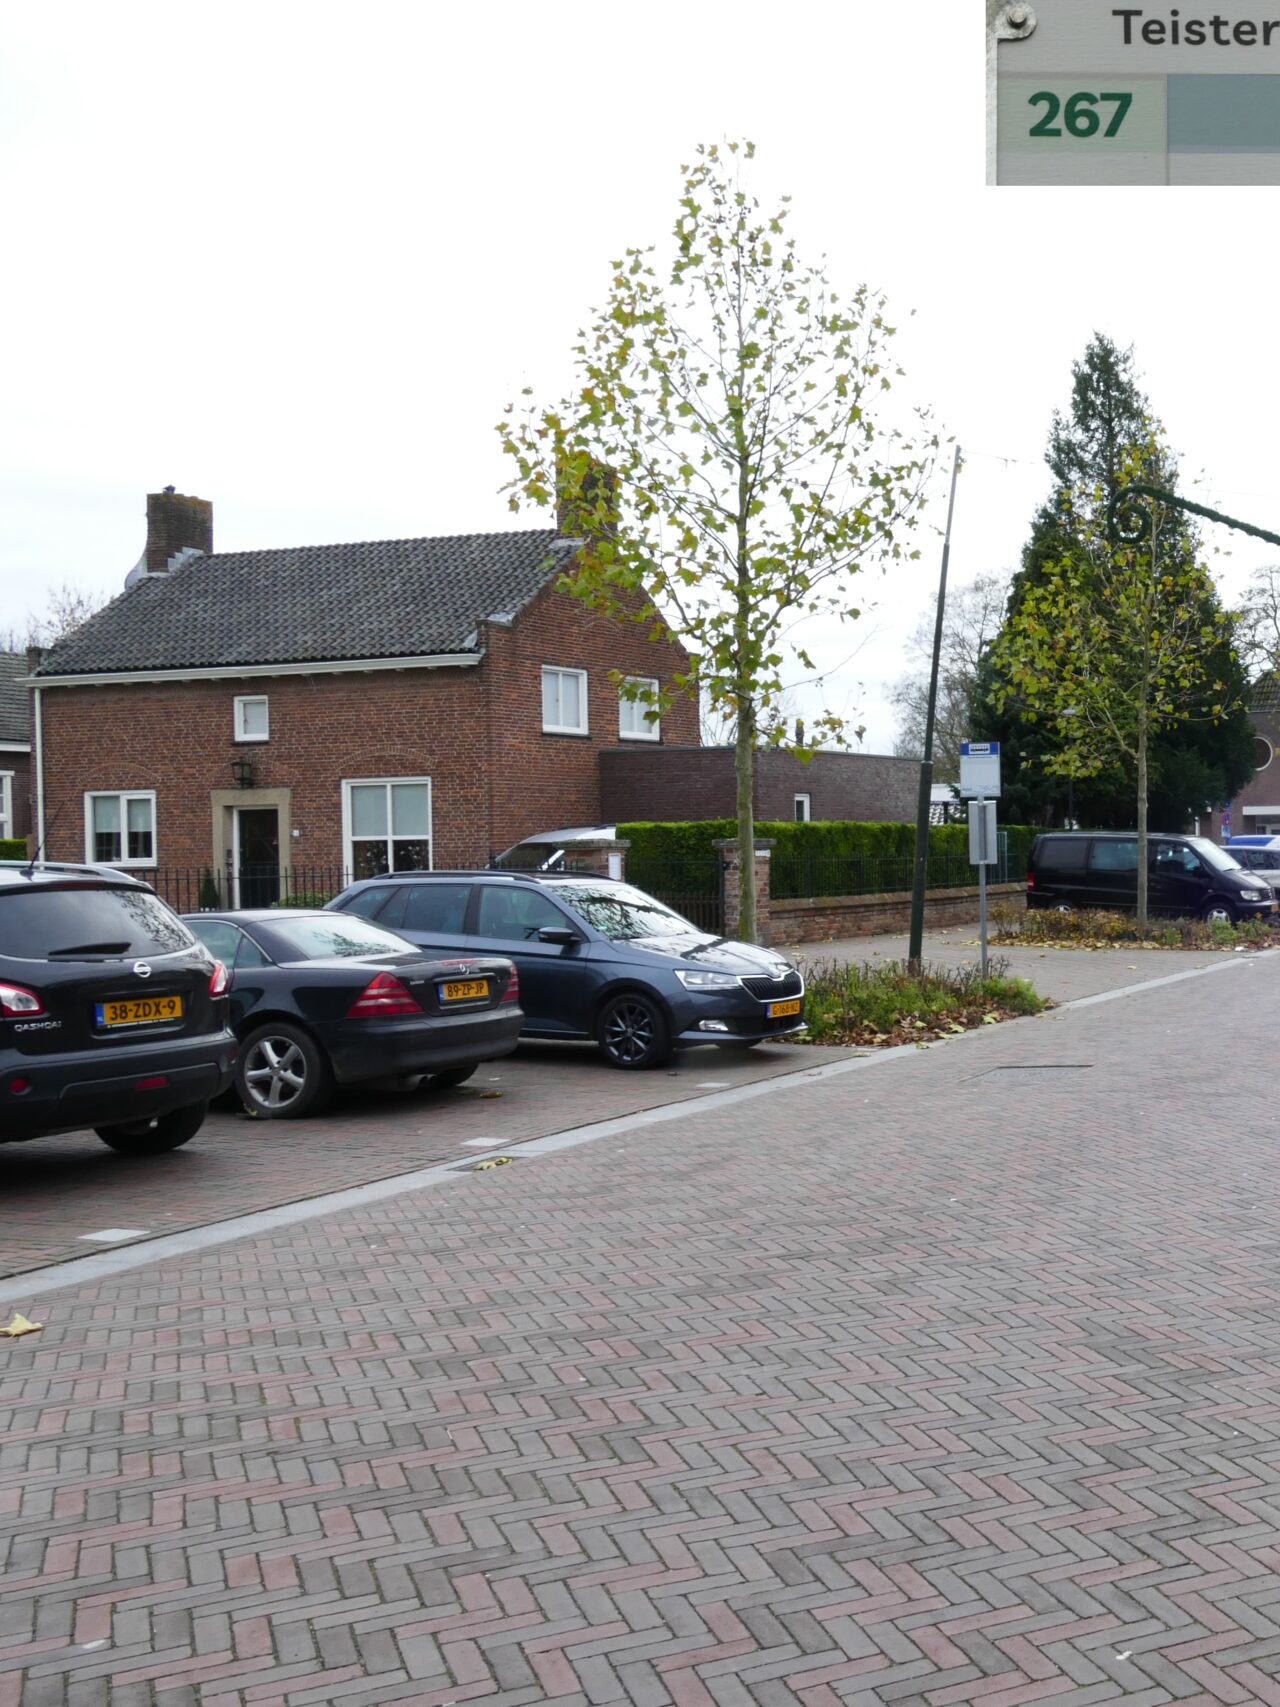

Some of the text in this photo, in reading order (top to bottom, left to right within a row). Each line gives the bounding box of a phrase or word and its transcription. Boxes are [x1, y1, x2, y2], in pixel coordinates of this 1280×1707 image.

[1027, 91, 1133, 138] 267
[447, 982, 485, 999] 89-ZP-JP
[109, 999, 177, 1022] 38-ZDX-9
